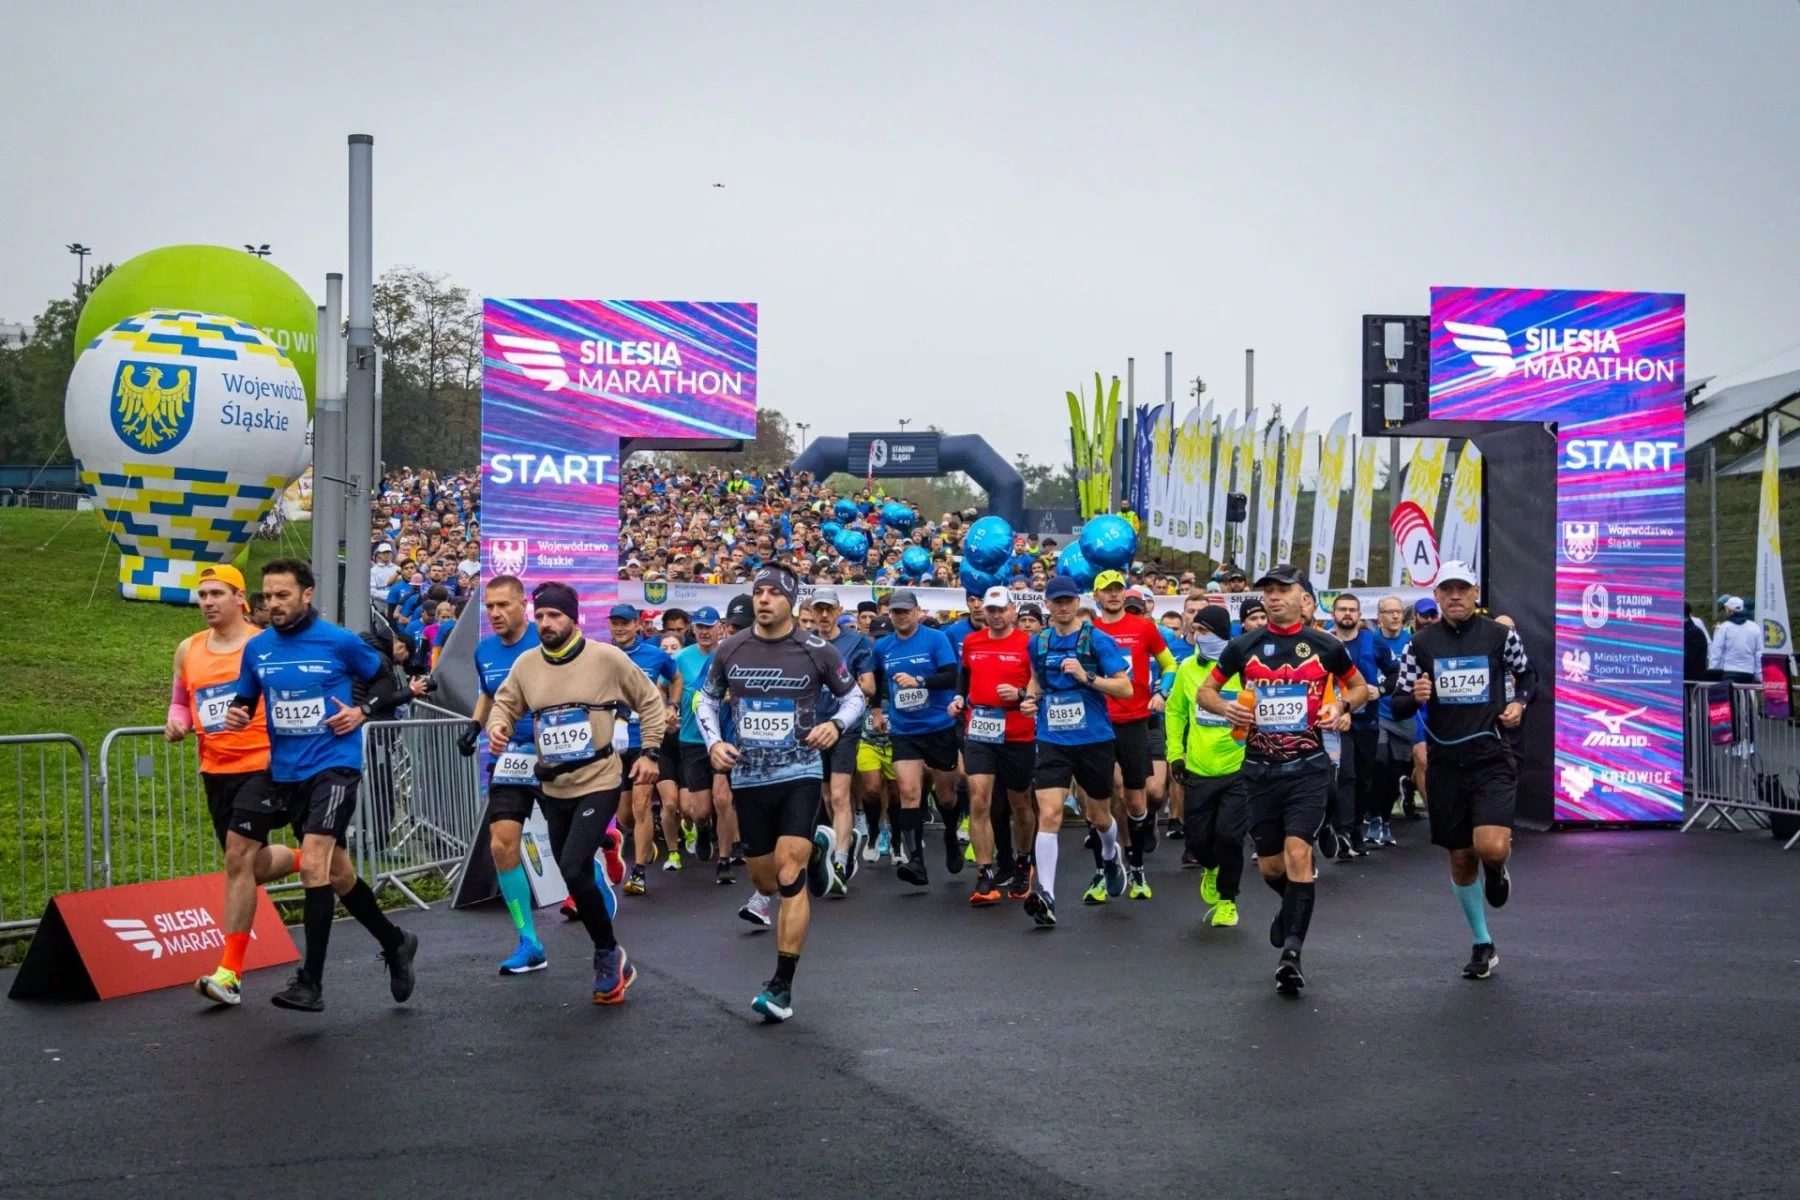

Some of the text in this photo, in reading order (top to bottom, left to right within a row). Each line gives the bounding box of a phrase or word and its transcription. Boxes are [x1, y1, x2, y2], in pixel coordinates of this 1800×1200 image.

[1524, 328, 1621, 354] SILESIA
[579, 340, 683, 367] SILESIA
[1523, 357, 1675, 382] MARATHON
[578, 369, 742, 395] MARATHON
[221, 404, 290, 432] Śląskie
[1565, 439, 1678, 472] START
[490, 454, 612, 485] START
[1095, 527, 1120, 548] 4:15
[1607, 523, 1674, 539] Województwo
[537, 540, 609, 554] Województwo
[969, 527, 987, 553] 4:15
[1607, 537, 1641, 550] Śląskie
[1413, 540, 1430, 565] A
[537, 554, 574, 569] Śląskie
[1011, 592, 1043, 601] ILESIA
[1616, 595, 1653, 606] STADION
[1616, 605, 1646, 621] ŚLĄSKI
[1594, 651, 1653, 663] Ministerstwo
[1594, 664, 1625, 675] Sportu
[1632, 664, 1673, 677] Turystyki
[1439, 674, 1485, 689] B1744
[899, 690, 923, 703] B968
[275, 704, 321, 719] B1124
[1049, 707, 1082, 719] B1814
[1259, 702, 1303, 717] B1239
[743, 716, 789, 731] B1055
[971, 719, 1001, 732] B2001
[542, 728, 588, 746] B1196
[504, 757, 529, 770] B66
[1601, 771, 1672, 784] KATOWICE
[153, 907, 216, 933] SILESIA
[163, 929, 257, 956] MARATH
